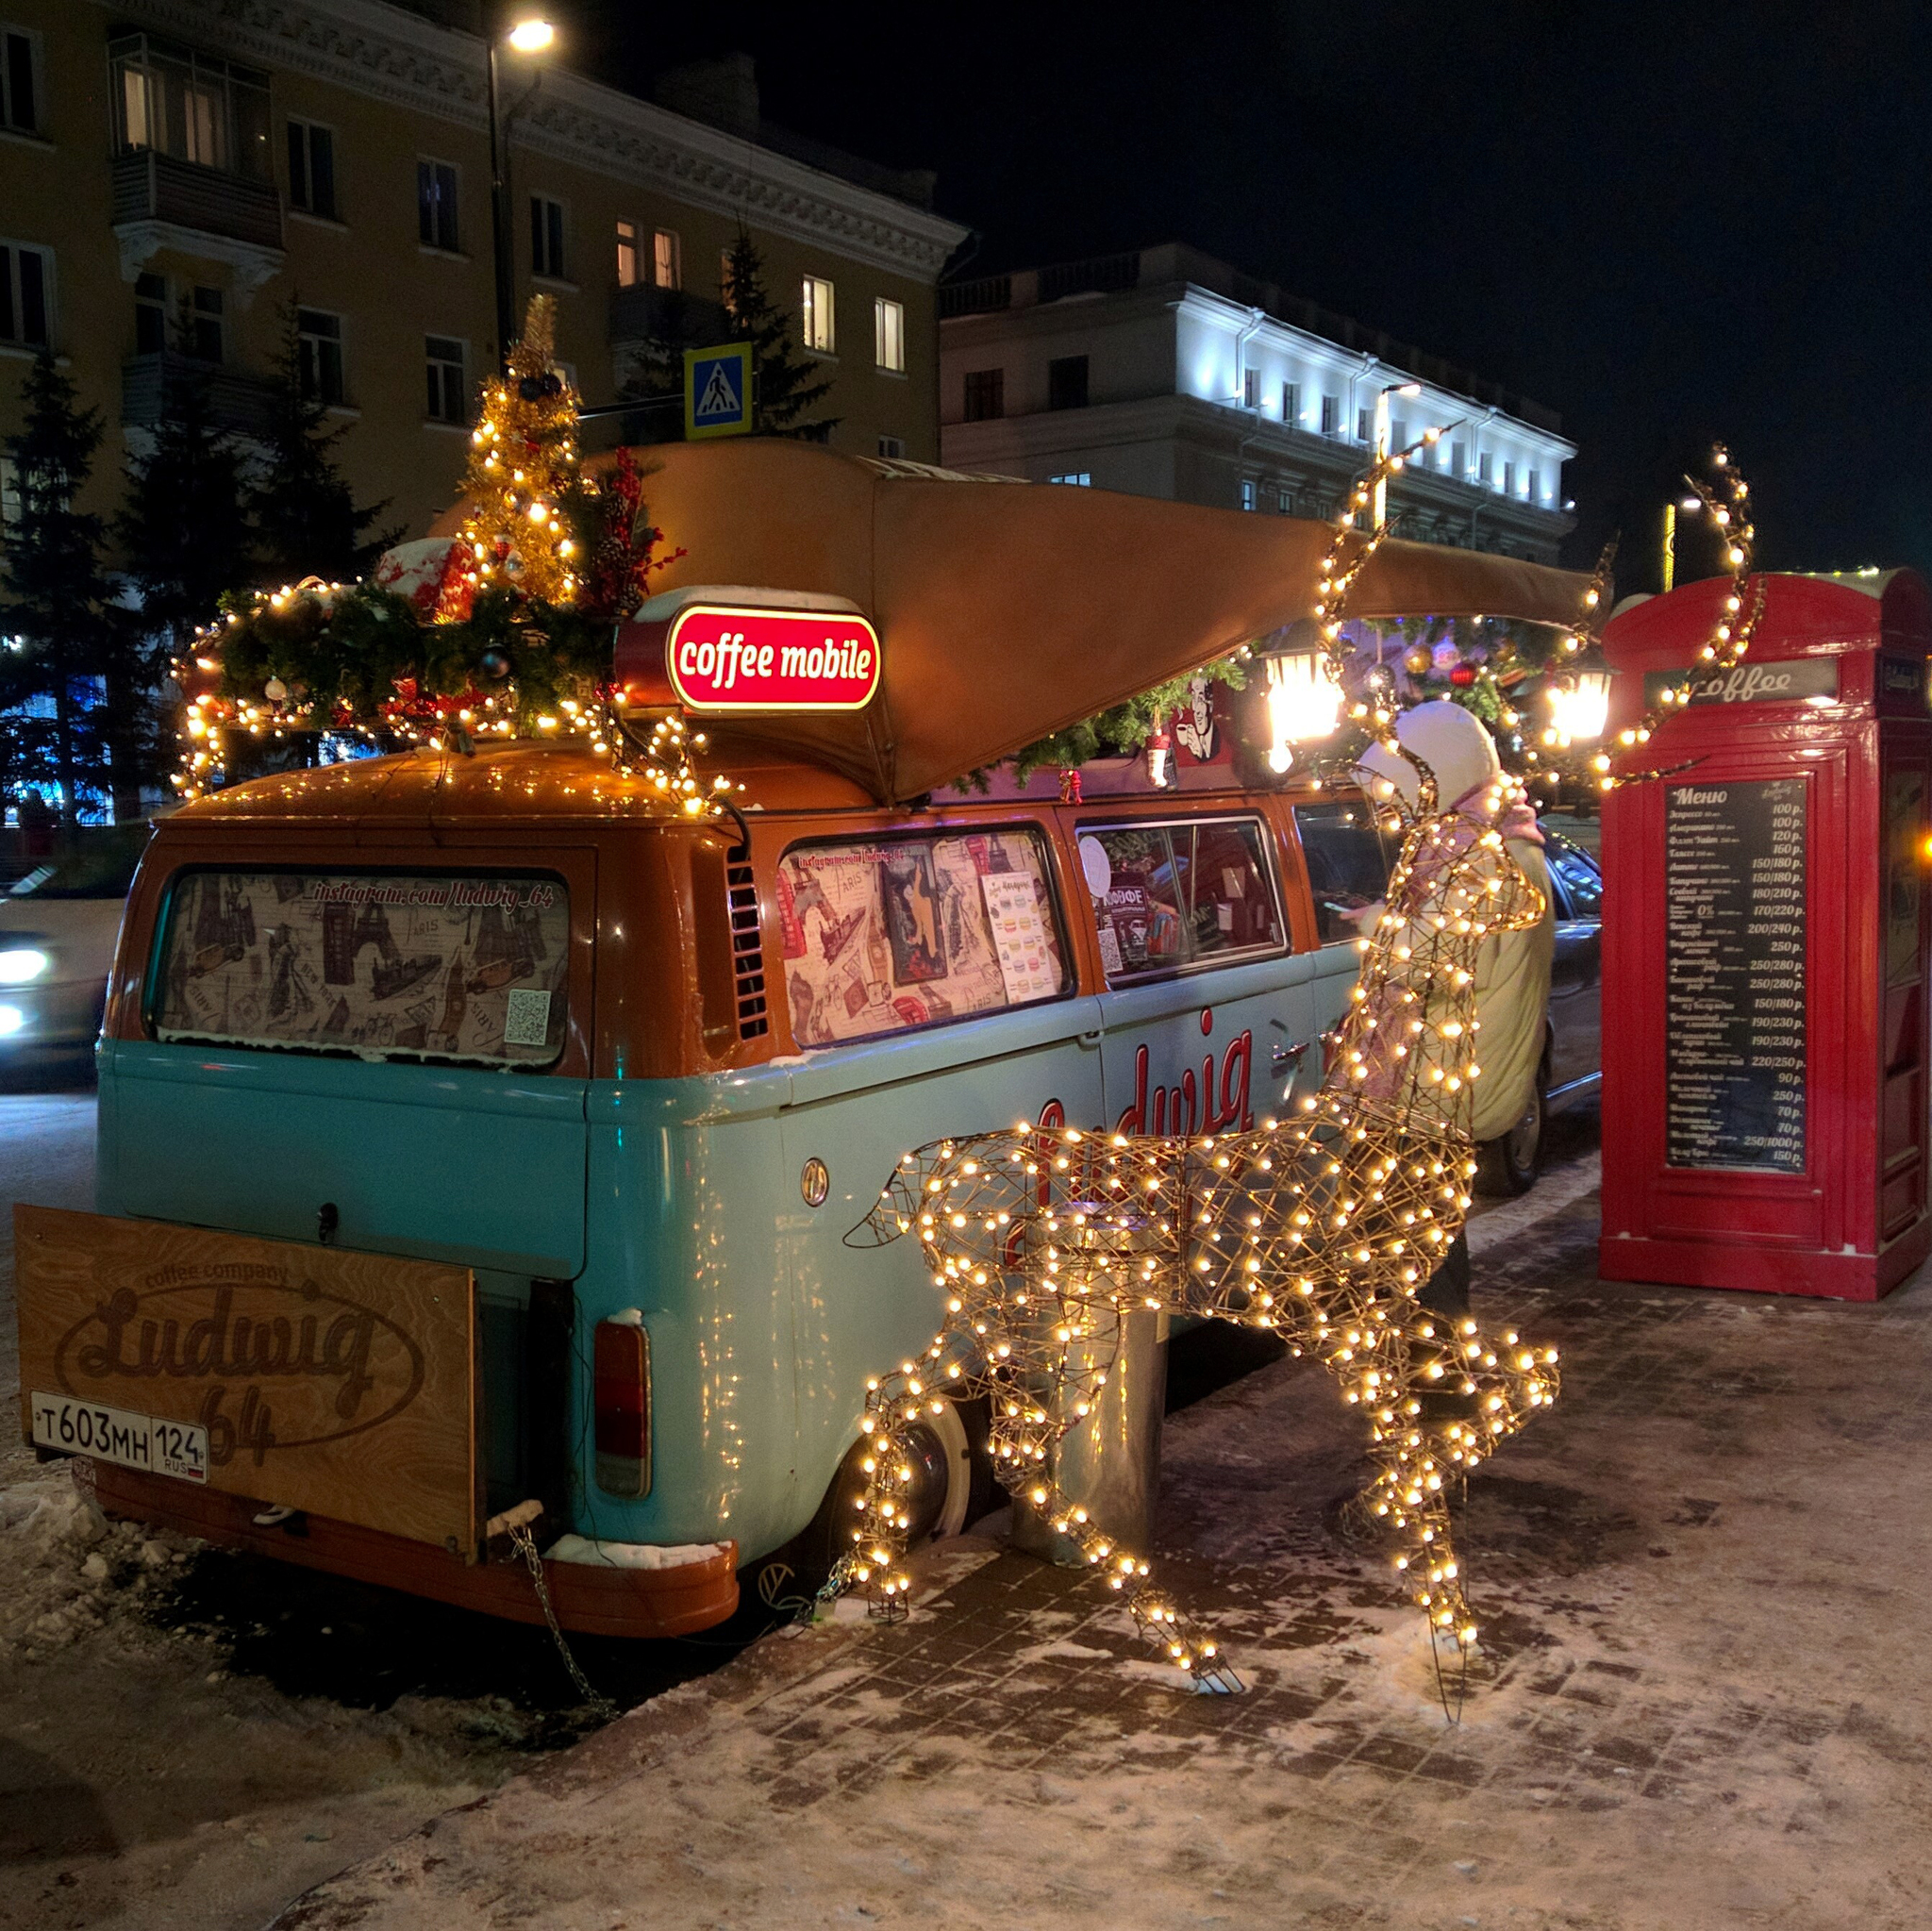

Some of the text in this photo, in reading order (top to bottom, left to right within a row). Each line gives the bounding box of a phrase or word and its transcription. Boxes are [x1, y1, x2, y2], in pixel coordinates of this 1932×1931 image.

[680, 632, 871, 690] coffee mobile
[1693, 666, 1790, 702] coffee
[1676, 788, 1727, 805] Меню
[1774, 804, 1791, 814] 100
[1774, 817, 1791, 827] 100
[1773, 831, 1791, 841] 120
[1774, 843, 1791, 854] 160
[314, 881, 555, 915] instagram.com/ludwig_64
[1771, 941, 1791, 952] 250
[1778, 1073, 1792, 1083] 90
[1774, 1090, 1793, 1100] 250
[1778, 1106, 1791, 1116] 70
[1778, 1123, 1791, 1133] 70
[1774, 1151, 1791, 1161] 150
[144, 1262, 290, 1289] coffee company
[78, 1286, 376, 1420] Ludwig
[199, 1385, 276, 1468] 64
[42, 1406, 199, 1463] Т603МН 124
[164, 1458, 188, 1474] RUS
